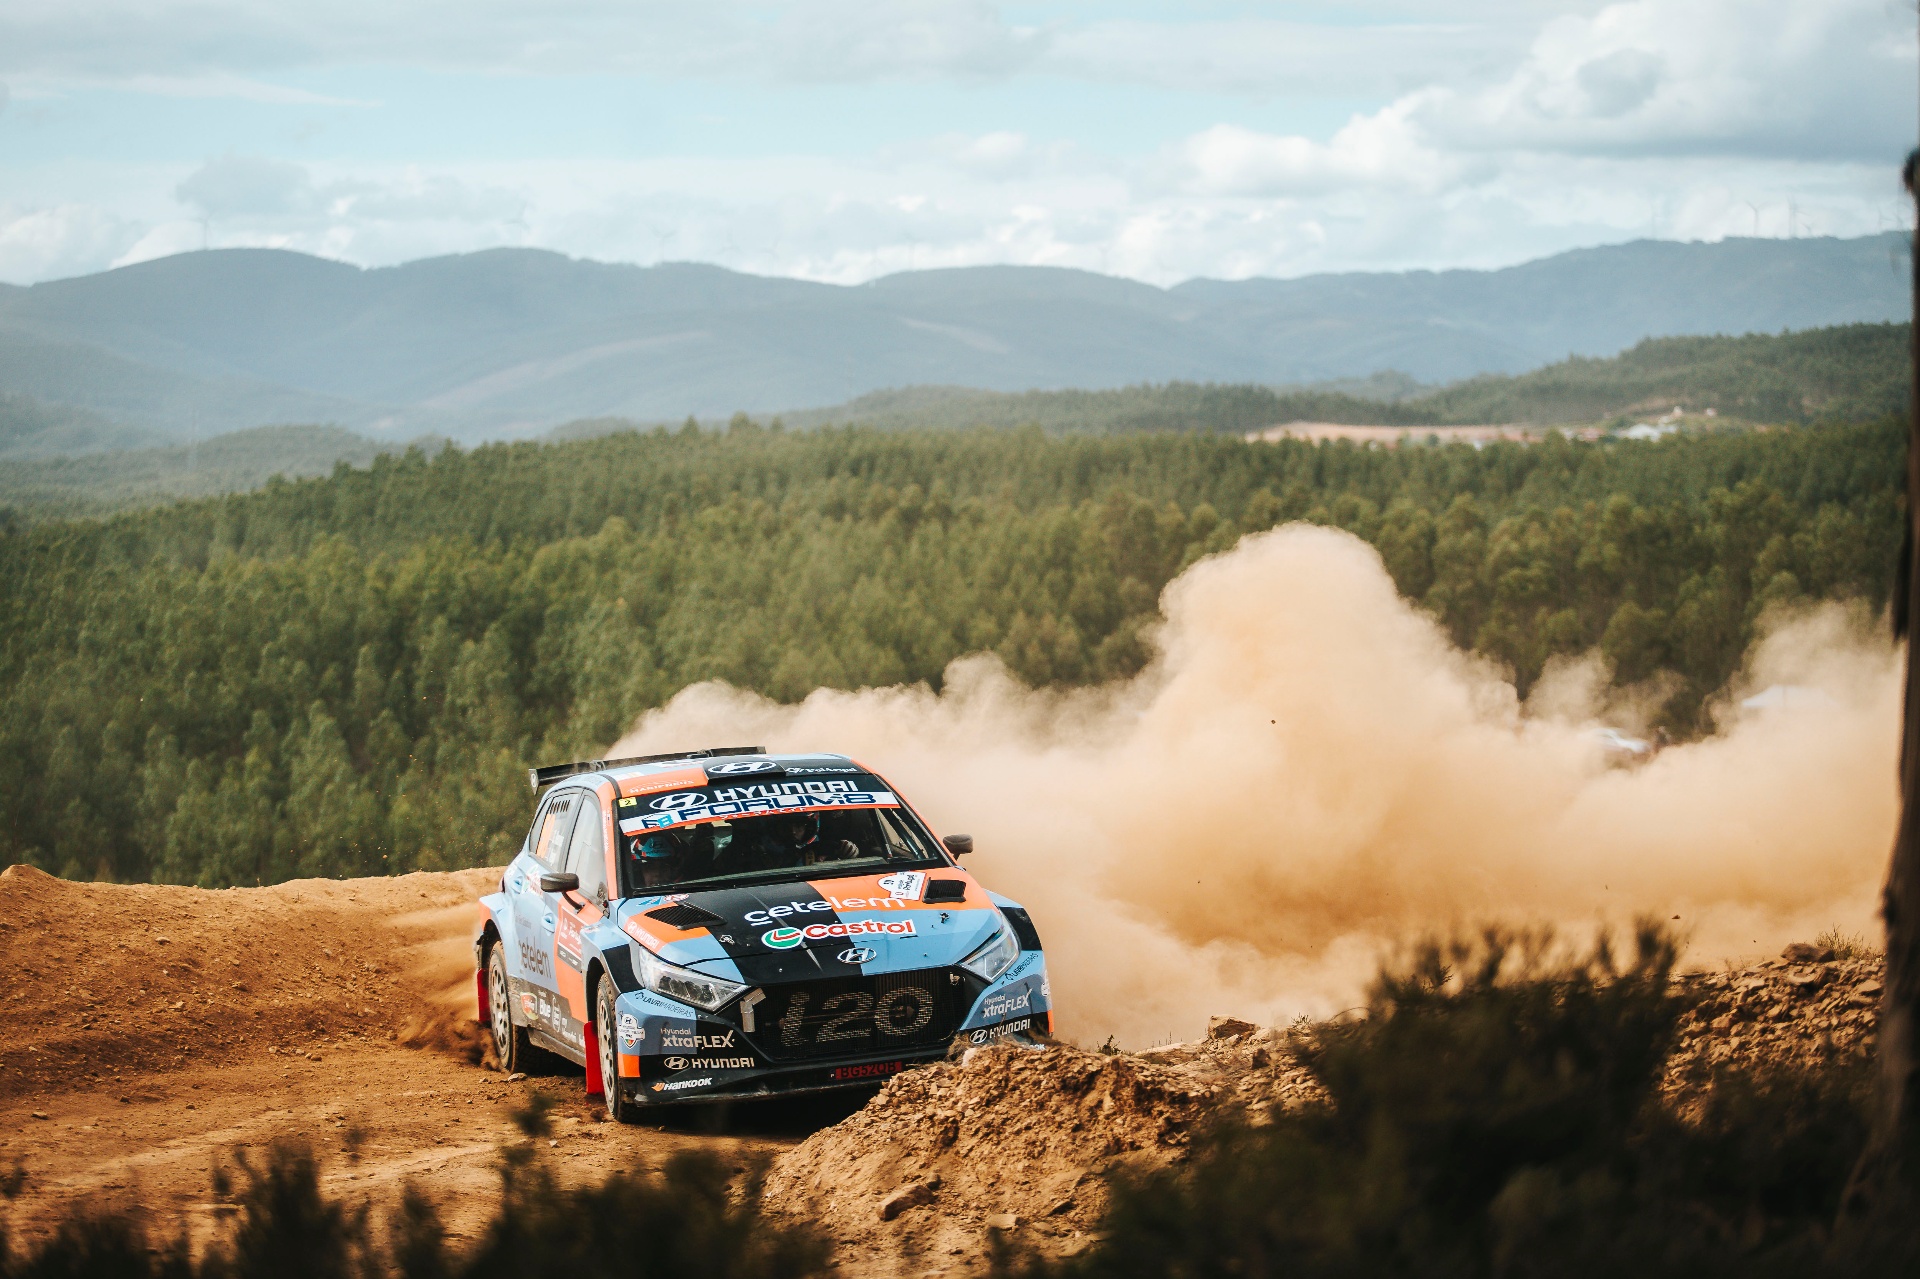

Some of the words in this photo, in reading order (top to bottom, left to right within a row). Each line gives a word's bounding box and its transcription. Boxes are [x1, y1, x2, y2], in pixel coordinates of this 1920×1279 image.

[714, 781, 858, 801] HYUNDAI
[678, 793, 877, 820] FORUM8
[744, 897, 905, 926] cetelem
[636, 925, 659, 949] HYUNDAI
[805, 921, 914, 939] Castrol
[643, 997, 693, 1018] LAVRIMADEIRAS
[983, 988, 1033, 1018] xtraFLEX
[781, 986, 933, 1047] i20
[660, 1028, 691, 1036] Hyundai
[663, 1030, 734, 1048] xtraFLEX
[989, 1019, 1031, 1039] HYUNDAI
[691, 1057, 755, 1069] HYUNDAI
